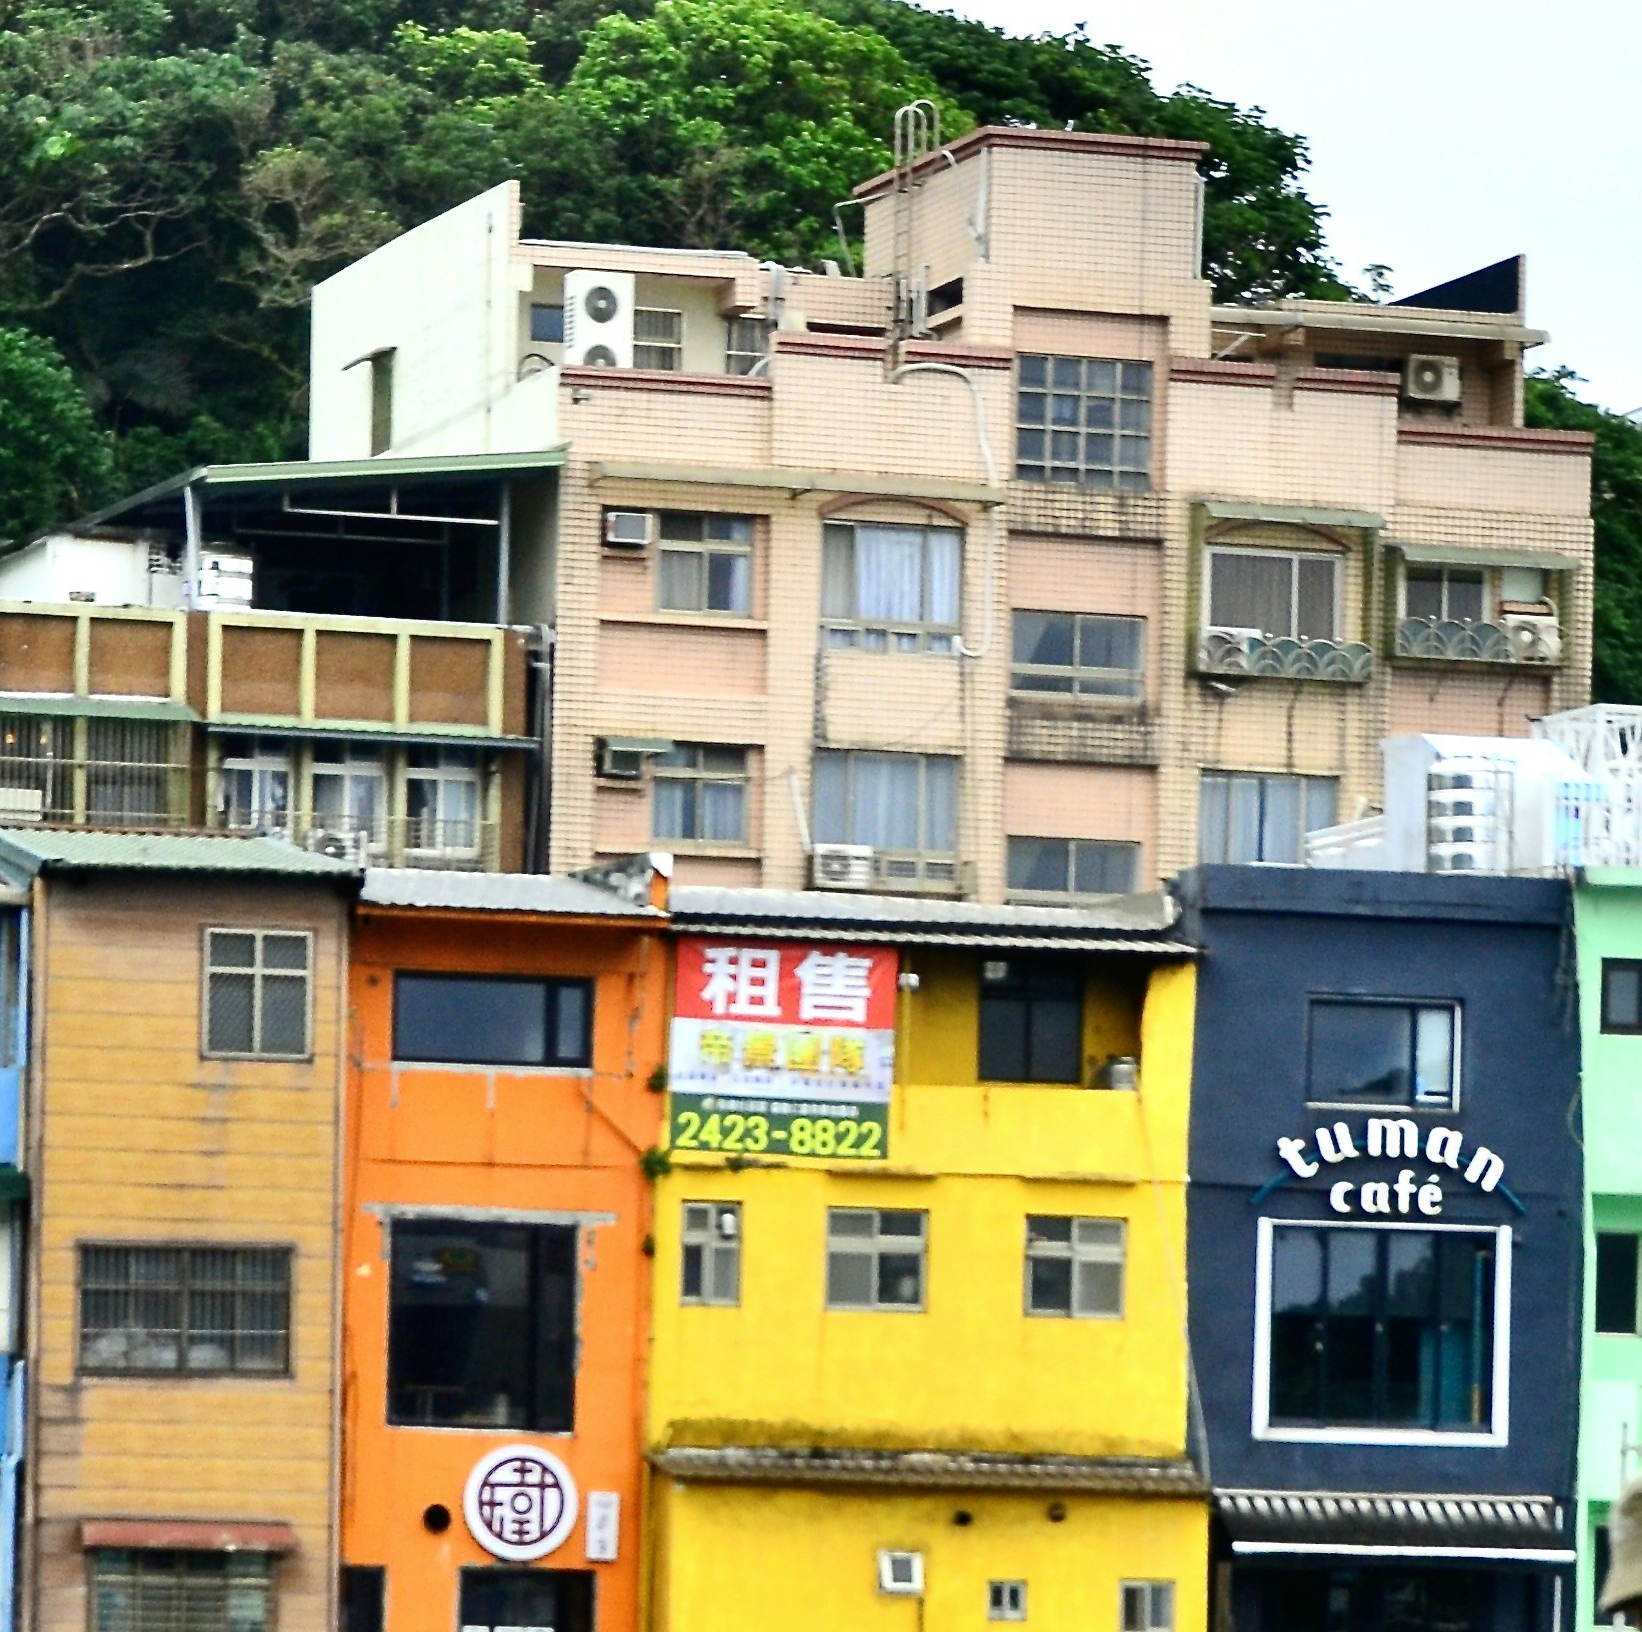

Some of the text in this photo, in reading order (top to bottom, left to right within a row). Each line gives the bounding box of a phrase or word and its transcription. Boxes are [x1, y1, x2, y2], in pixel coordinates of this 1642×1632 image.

[700, 946, 874, 1023] 租售
[675, 1110, 882, 1157] 2423-8822
[1276, 1117, 1505, 1193] tuman
[1329, 1168, 1443, 1216] café
